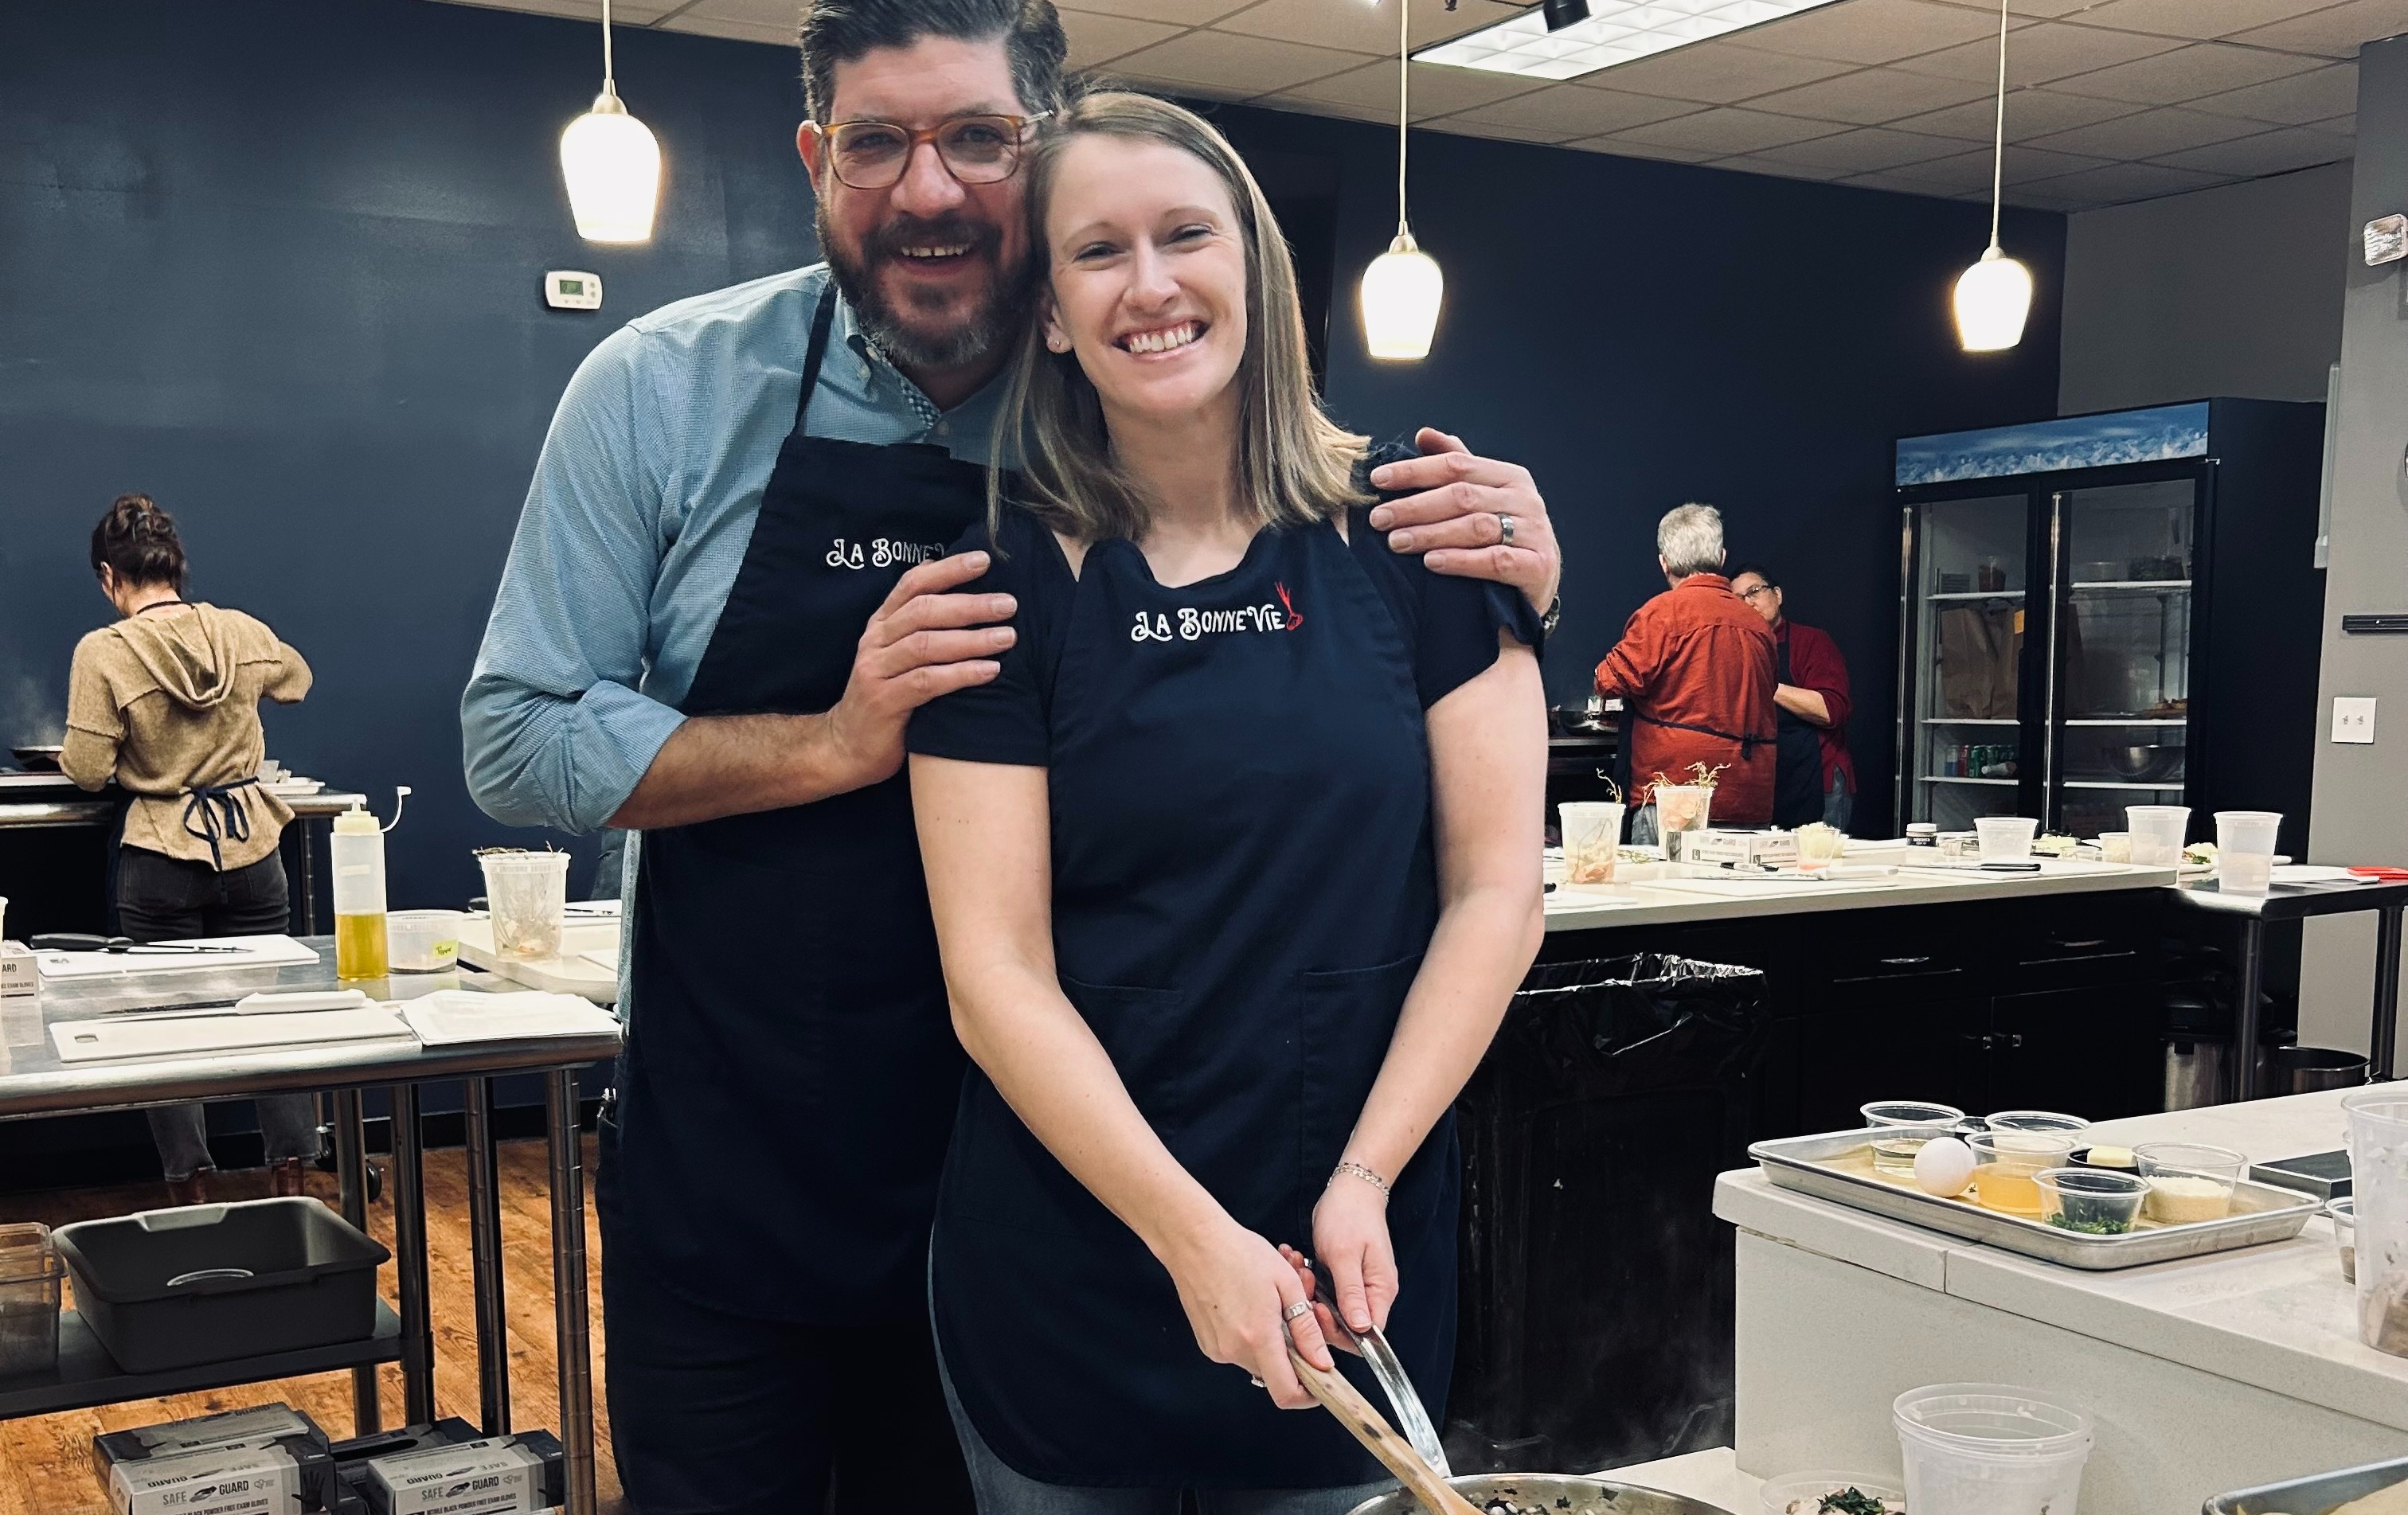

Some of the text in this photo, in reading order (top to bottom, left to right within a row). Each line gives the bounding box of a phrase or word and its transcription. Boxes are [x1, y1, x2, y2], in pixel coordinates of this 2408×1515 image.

[2, 963, 17, 973] ARD
[162, 1490, 188, 1506] SAFE
[219, 1480, 249, 1496] GUARD
[421, 1486, 444, 1501] SAFE
[472, 1476, 499, 1491] GUARD
